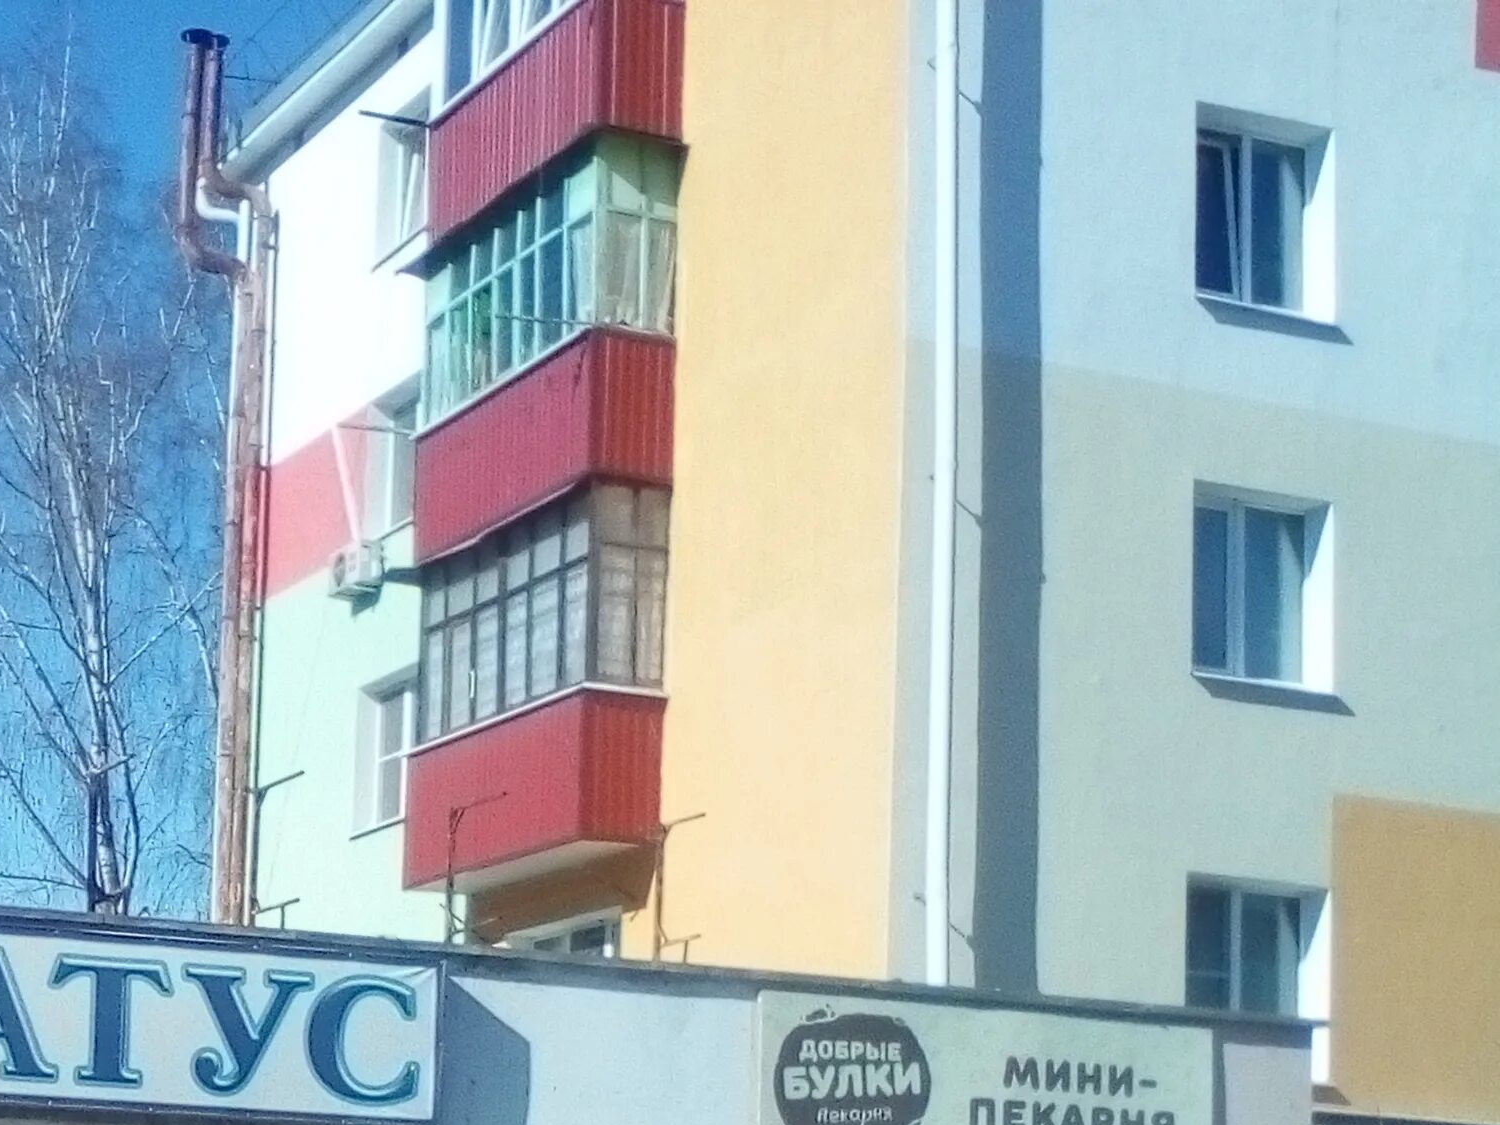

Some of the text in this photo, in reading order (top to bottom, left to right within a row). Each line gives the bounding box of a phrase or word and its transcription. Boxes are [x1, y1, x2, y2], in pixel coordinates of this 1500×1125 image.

[798, 1038, 902, 1063] ДОБРЫЕ
[782, 1060, 922, 1101] БУЛКИ
[1002, 1054, 1159, 1098] МИНИ-
